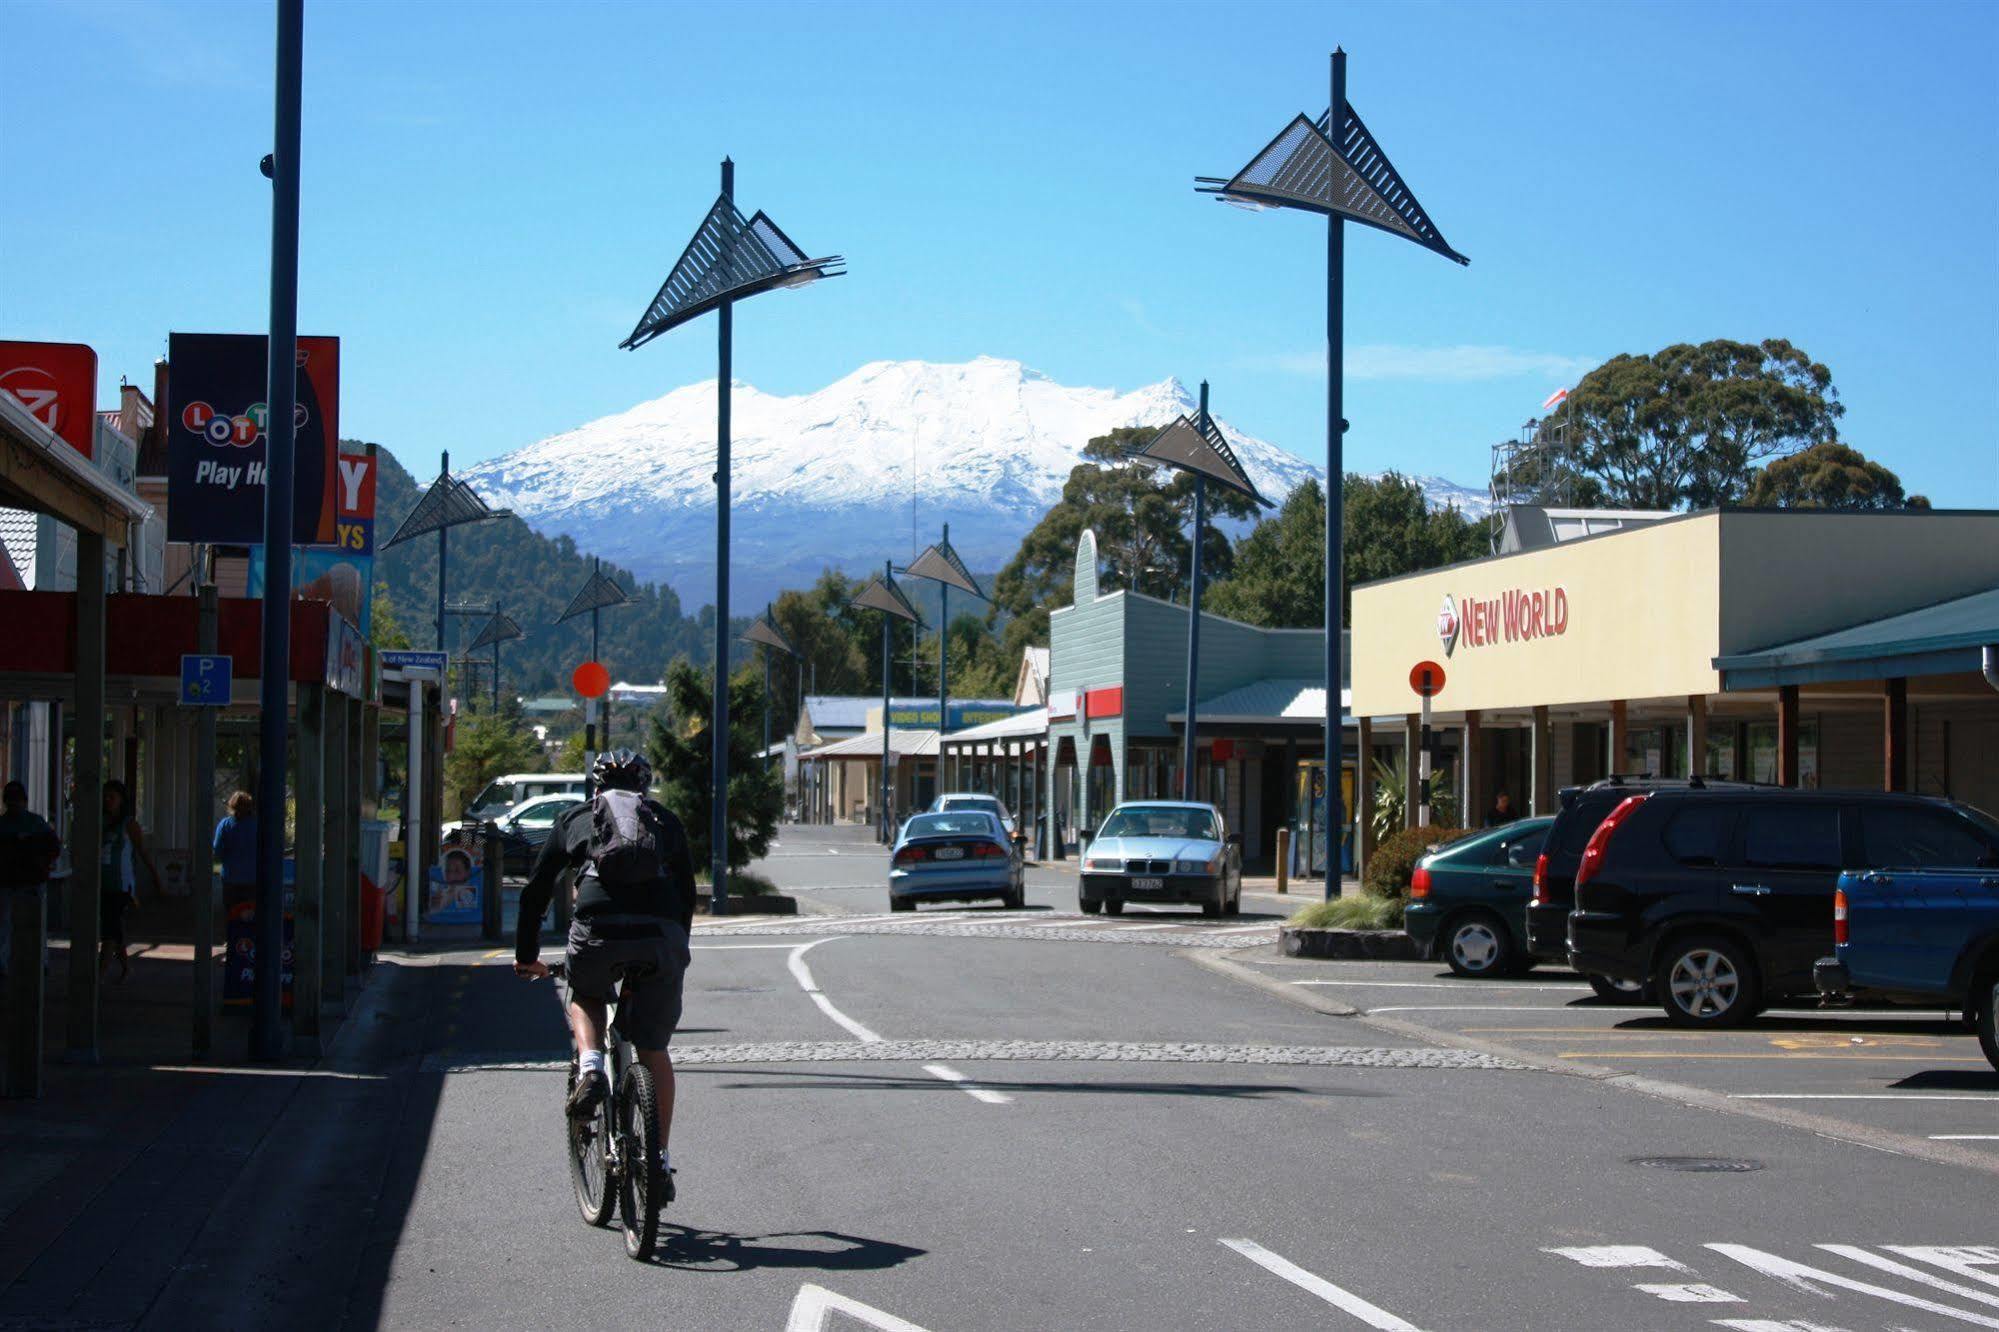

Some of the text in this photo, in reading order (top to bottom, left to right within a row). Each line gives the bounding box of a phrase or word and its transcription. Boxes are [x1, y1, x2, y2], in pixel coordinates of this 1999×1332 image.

[193, 406, 267, 441] LOTT
[195, 460, 241, 490] Play
[1461, 587, 1569, 649] NEW WORLD
[200, 659, 215, 677] P
[920, 711, 941, 724] SHO
